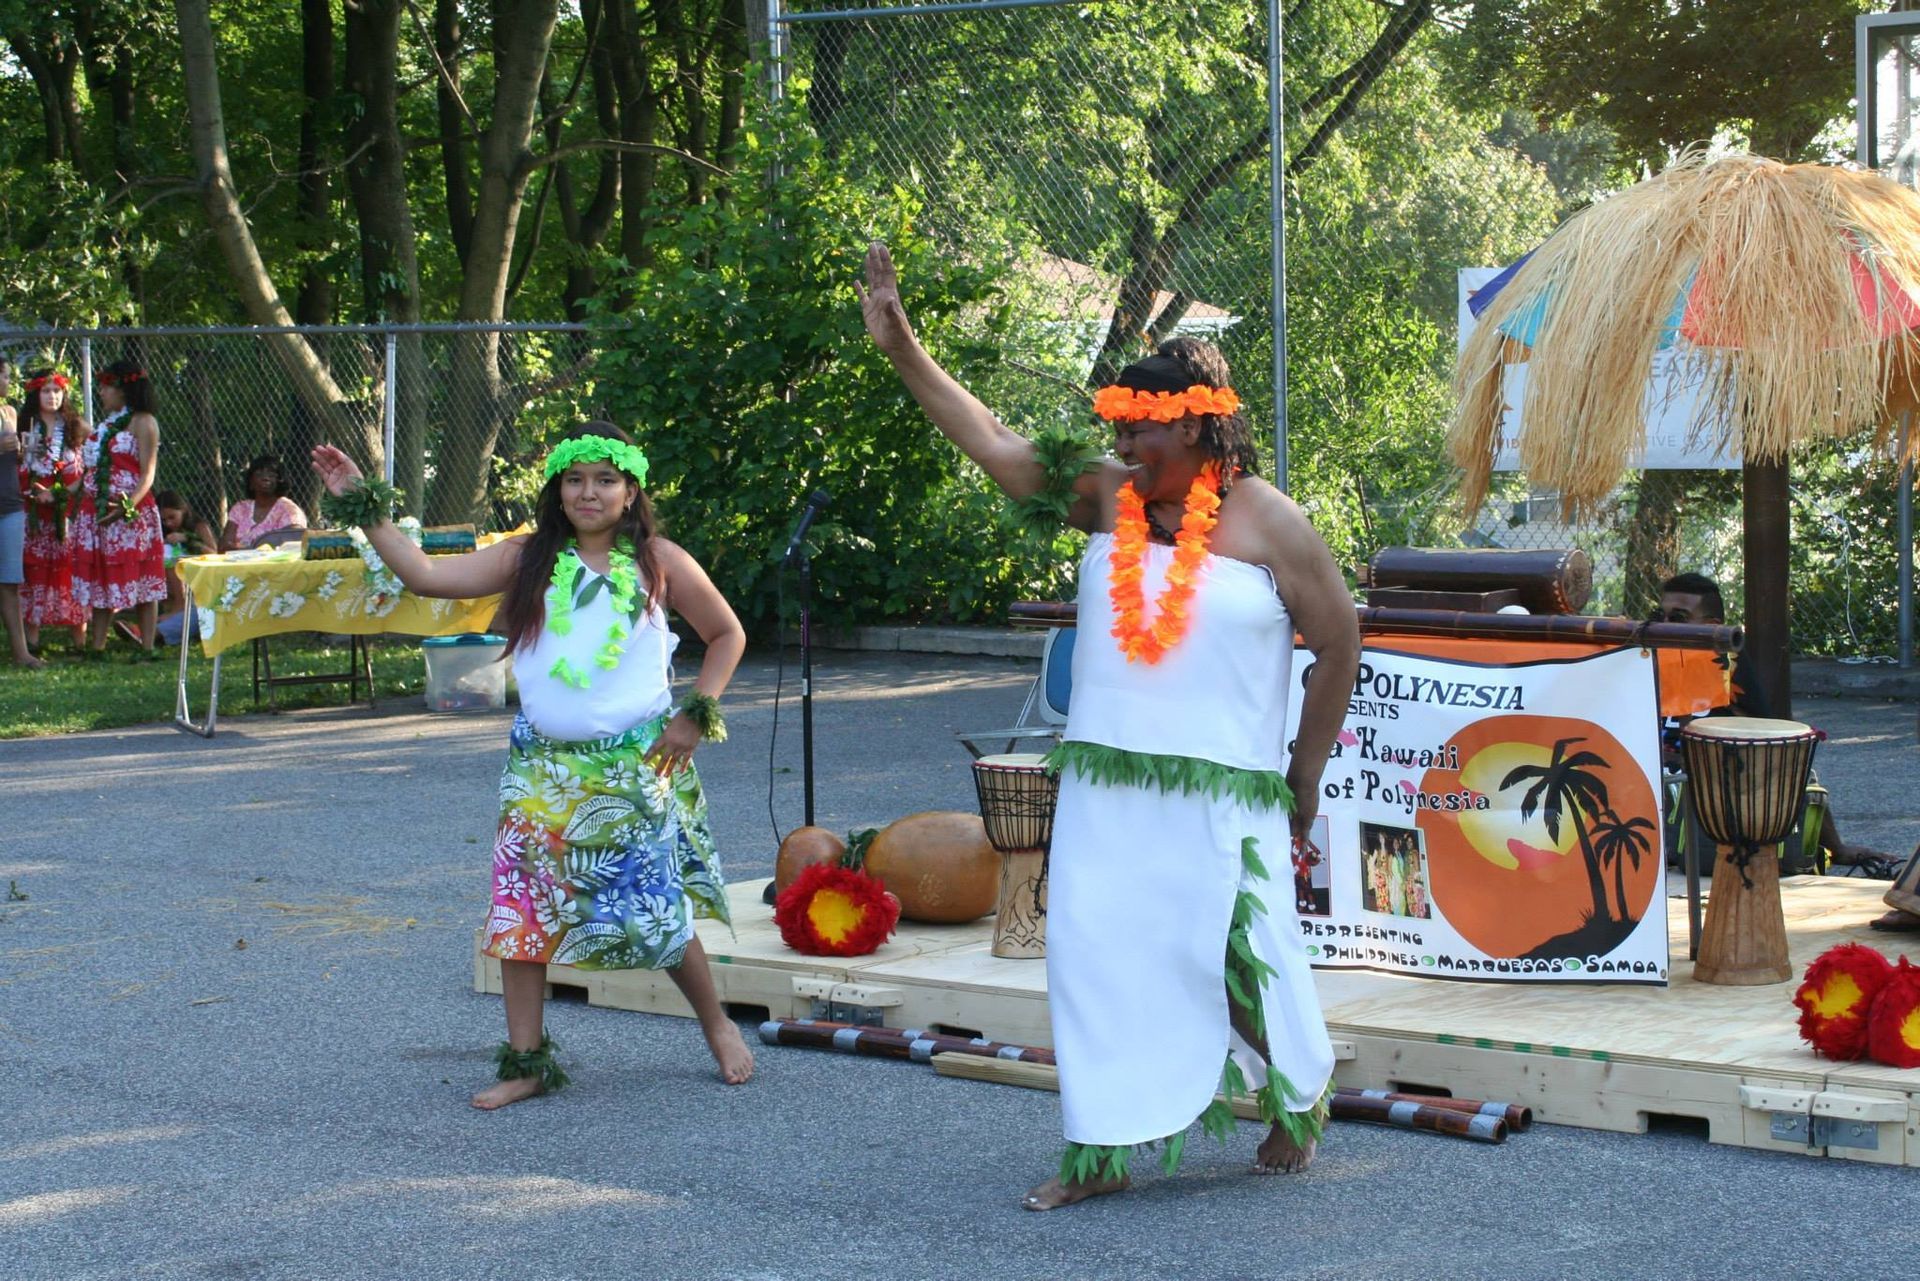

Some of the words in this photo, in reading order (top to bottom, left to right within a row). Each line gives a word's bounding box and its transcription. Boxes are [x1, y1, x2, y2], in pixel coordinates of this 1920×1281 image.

[1354, 664, 1524, 710] POLYNESIA
[1347, 700, 1399, 720] SENTS
[1356, 726, 1459, 769] Hawaii
[1324, 777, 1354, 799] of
[1360, 769, 1490, 815] Polynesia
[1300, 920, 1423, 945] REPRESENTING
[1322, 944, 1419, 967] PHILIPPINES
[1437, 954, 1562, 973] MARQUESAS
[1586, 955, 1658, 973] SAMOA
